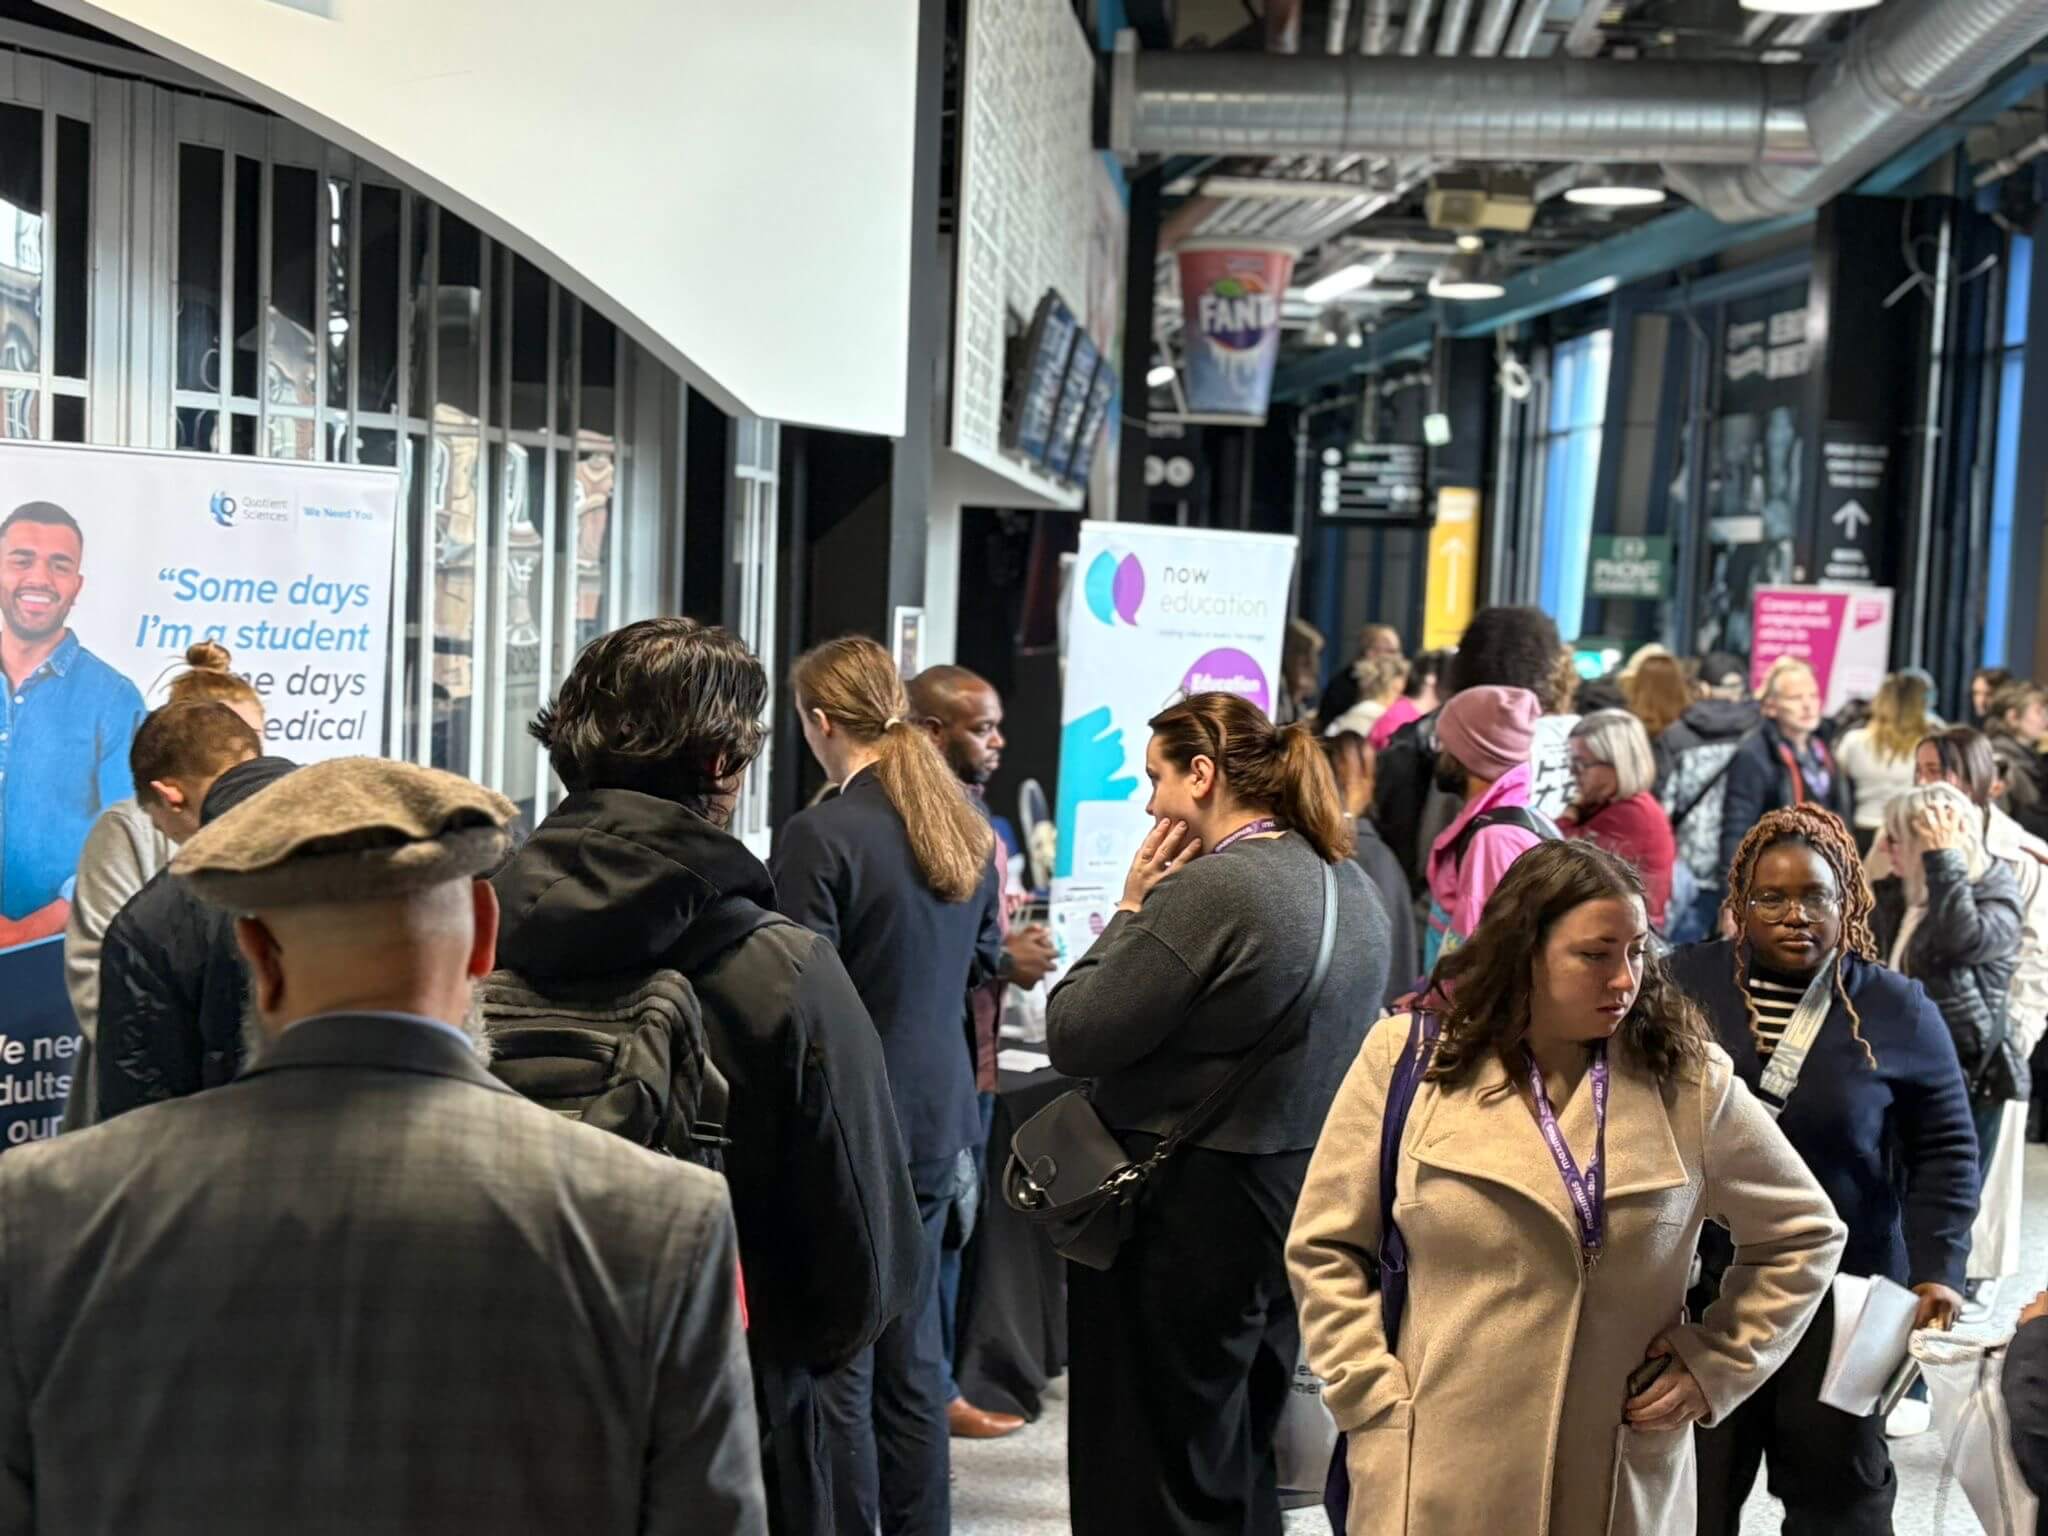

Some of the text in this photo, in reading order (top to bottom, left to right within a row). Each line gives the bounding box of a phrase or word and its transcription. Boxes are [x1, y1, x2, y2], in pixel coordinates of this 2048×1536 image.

[242, 496, 288, 509] Quotient
[242, 509, 288, 522] Sciences
[304, 507, 373, 520] We Need You
[1163, 566, 1210, 584] now
[159, 568, 370, 614] “Some days
[1160, 589, 1268, 617] education
[235, 620, 370, 652] student
[286, 665, 367, 704] days
[1190, 672, 1261, 694] Education
[264, 709, 367, 741] edical
[8, 1115, 65, 1143] our
[1546, 1122, 1571, 1170] maximus
[1571, 1180, 1595, 1230] maximus
